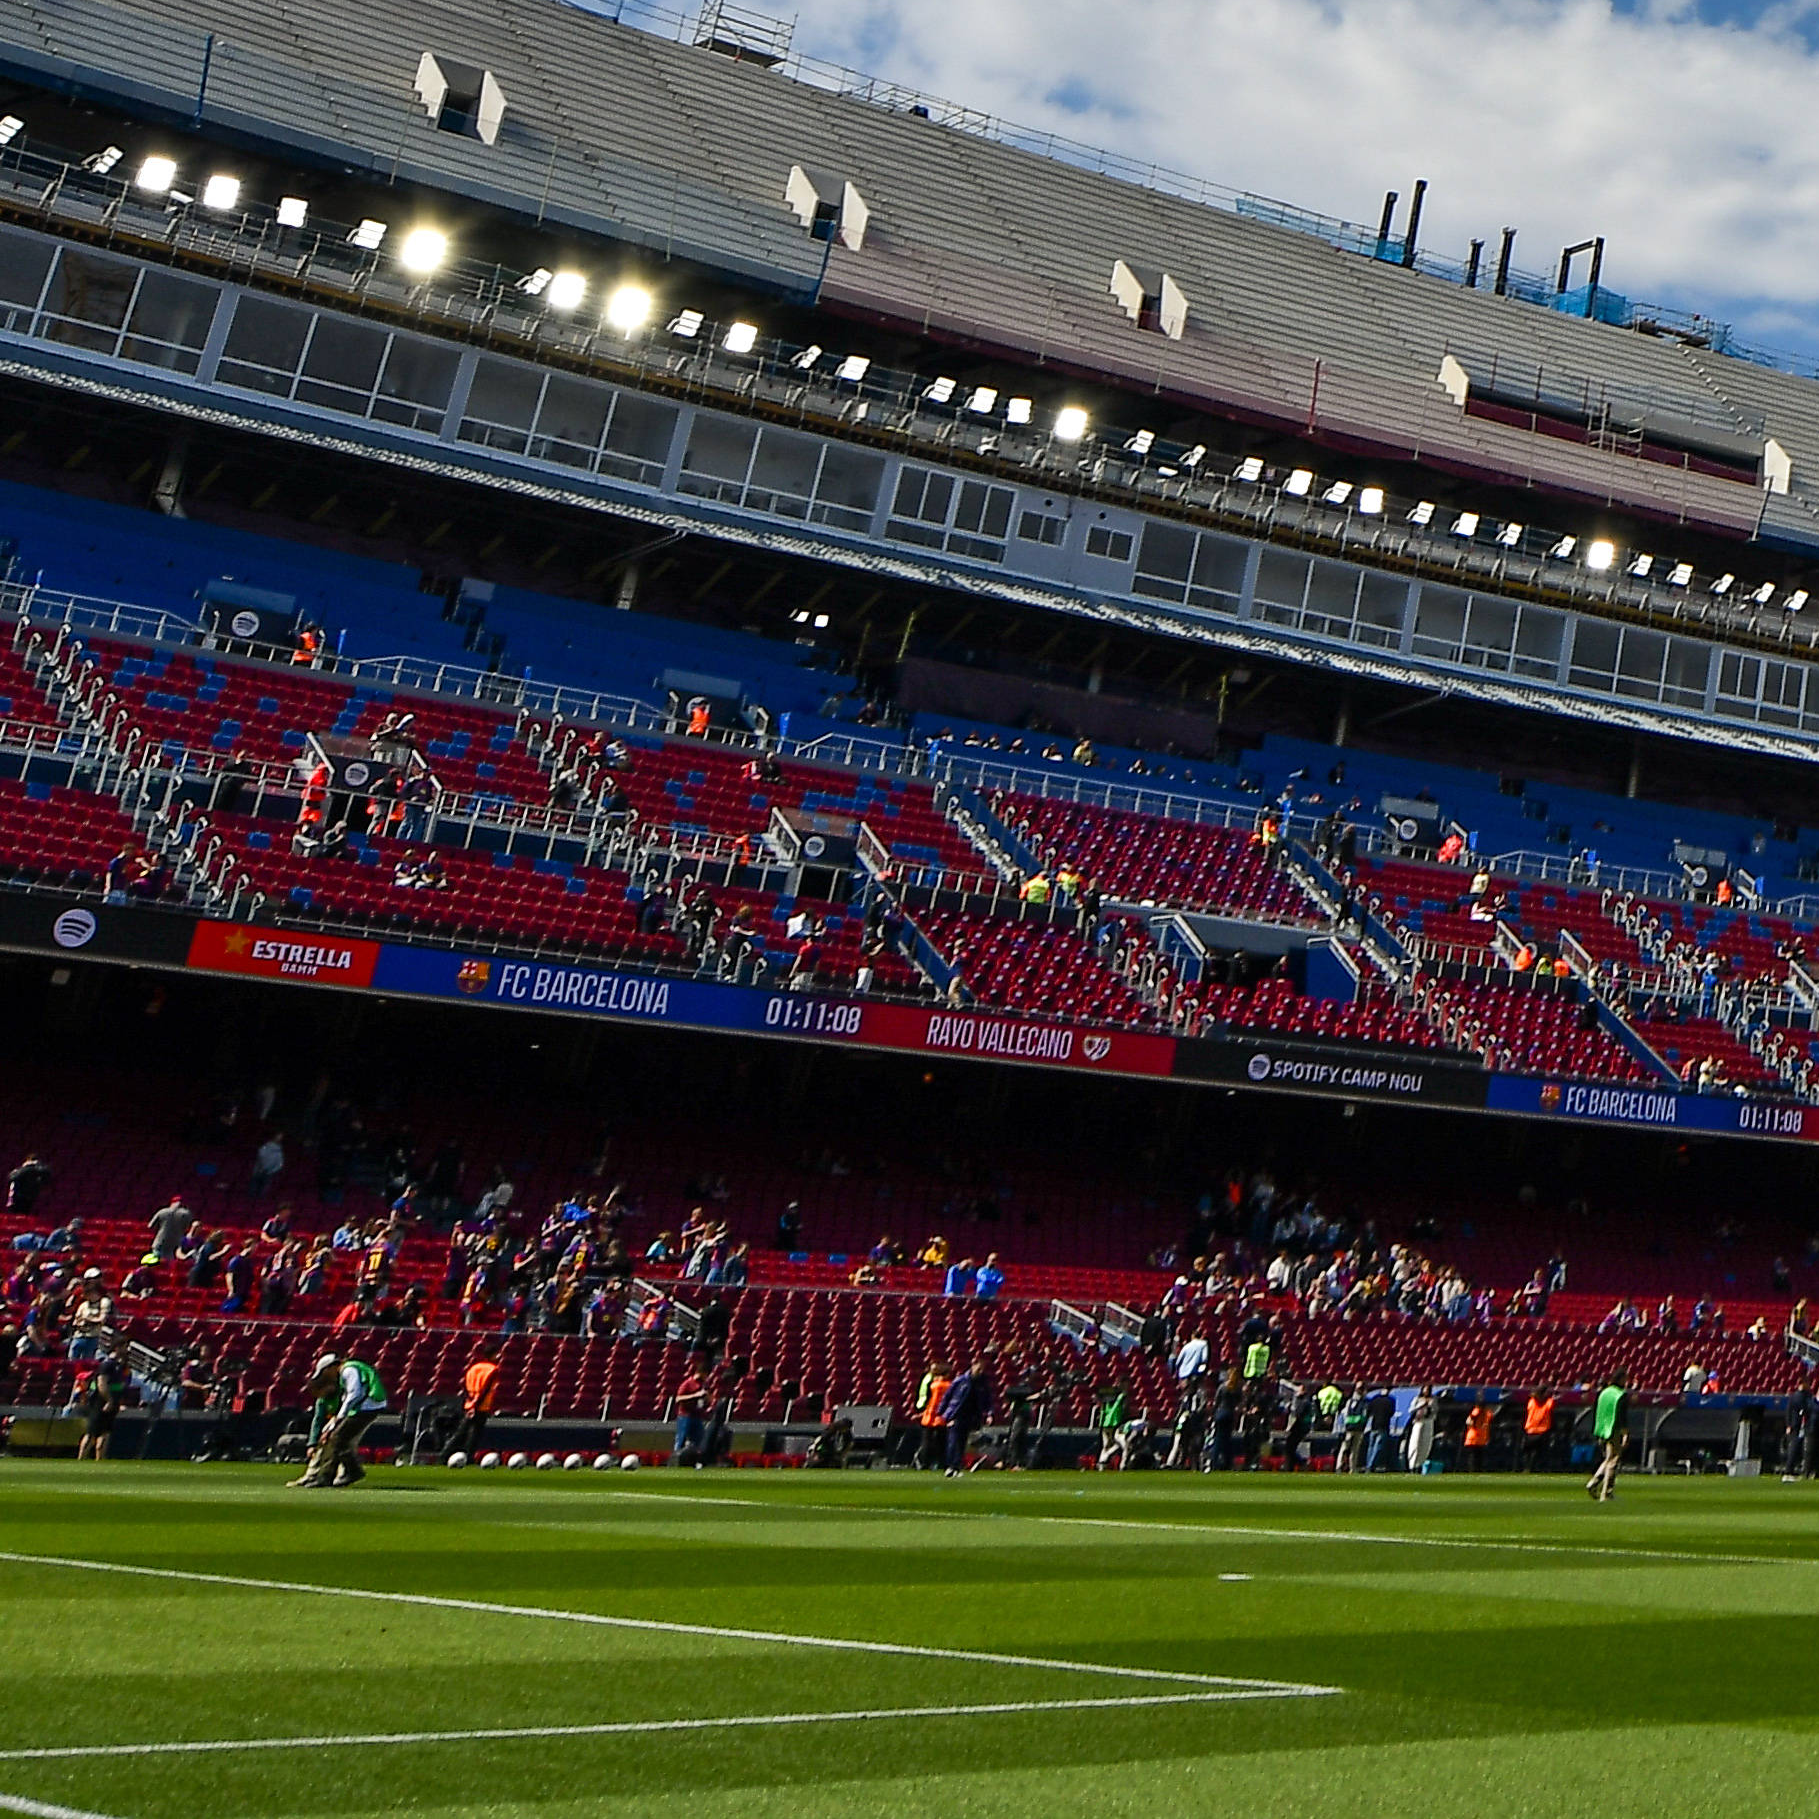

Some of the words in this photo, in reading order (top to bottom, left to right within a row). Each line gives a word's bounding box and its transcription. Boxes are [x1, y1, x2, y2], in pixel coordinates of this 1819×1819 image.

[252, 940, 352, 969] ESTRELLA
[497, 964, 530, 999] FC
[532, 968, 670, 1015] BARCELONA
[764, 997, 863, 1034] 01:11:08
[925, 1015, 974, 1049] RAYO
[976, 1021, 1073, 1060] VALLECANO
[1272, 1060, 1340, 1084] SPOTIFY
[1341, 1067, 1387, 1089] CAMP
[1388, 1074, 1423, 1093] NOU
[1565, 1086, 1586, 1114] FC
[1587, 1089, 1677, 1122] BARCELONA
[1738, 1105, 1803, 1133] 01:11:08
